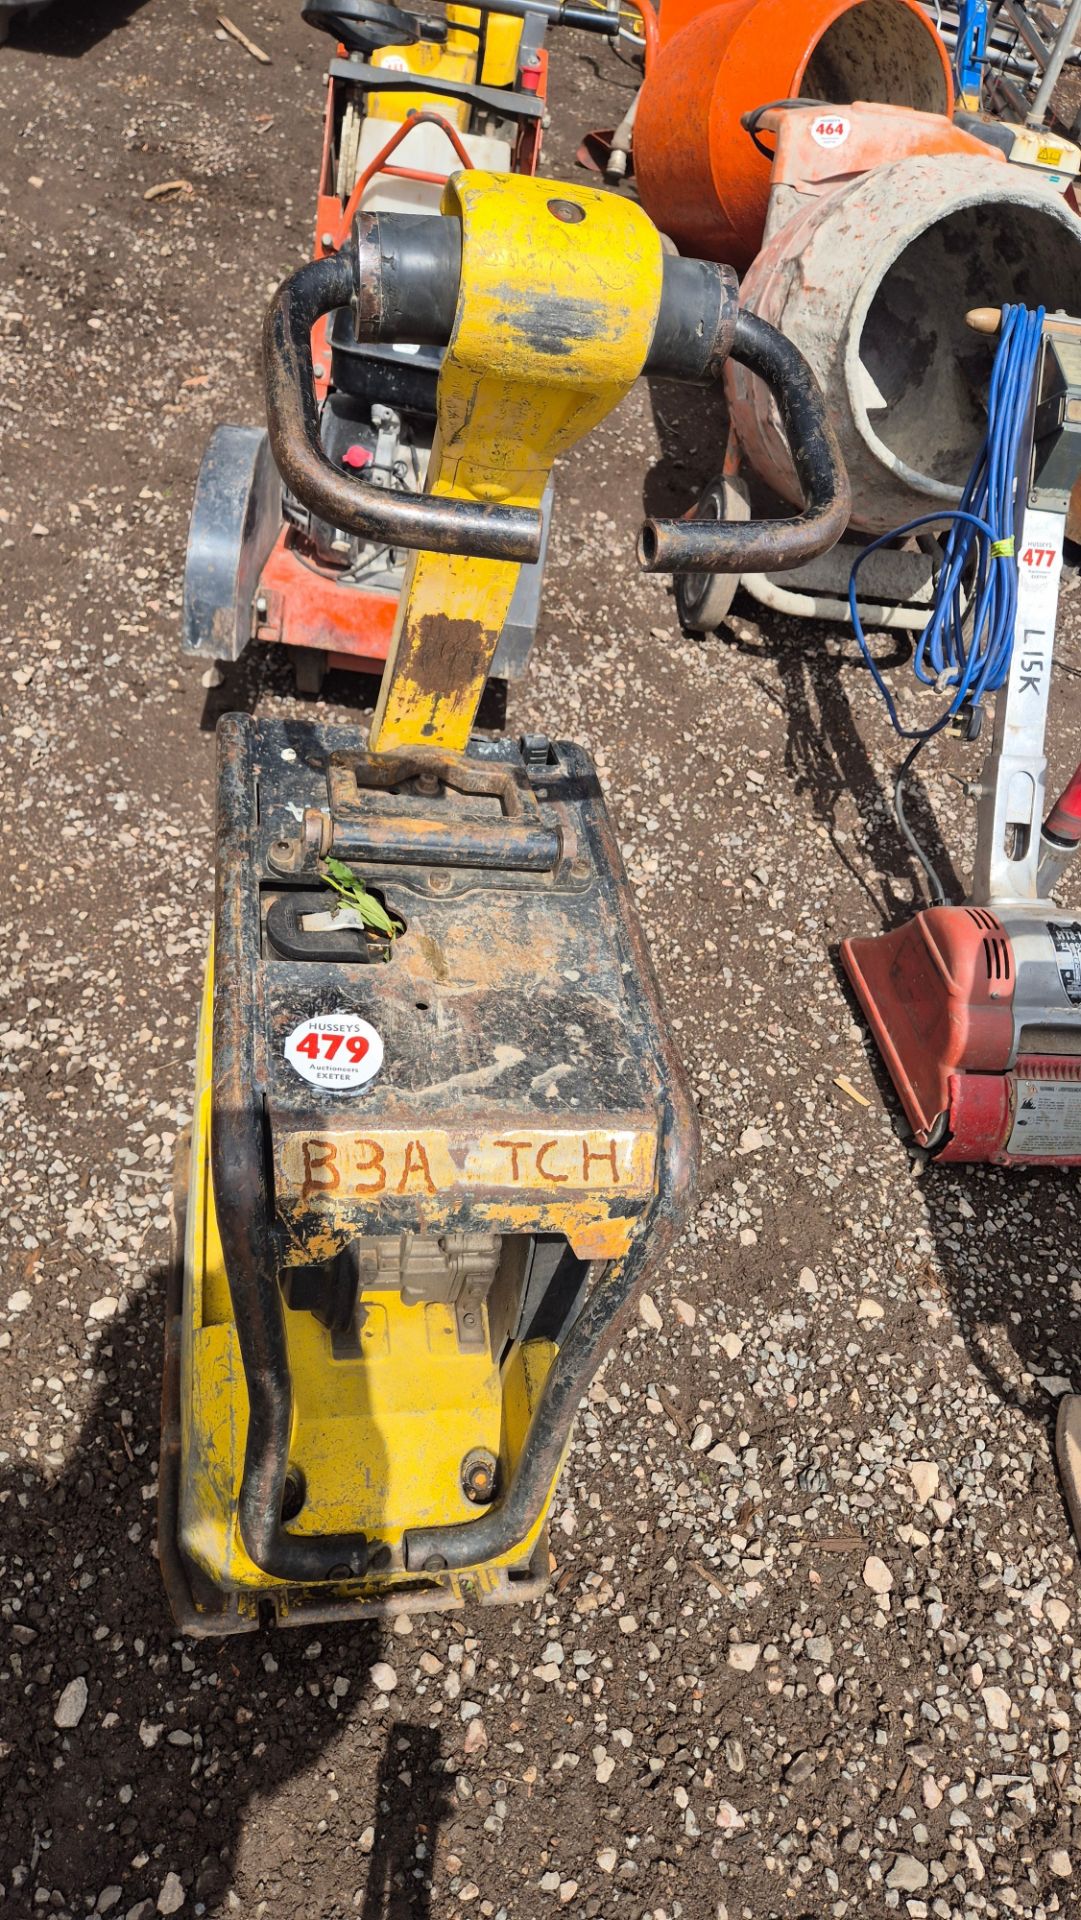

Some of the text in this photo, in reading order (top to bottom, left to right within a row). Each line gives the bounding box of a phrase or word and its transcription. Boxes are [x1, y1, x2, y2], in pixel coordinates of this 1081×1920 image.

[816, 123, 843, 135] 464
[1022, 548, 1056, 568] 477
[308, 1022, 361, 1033] HUSSEYS
[296, 1032, 370, 1064] 479
[309, 1063, 359, 1073] Auctioneers
[316, 1072, 352, 1081] EXETER
[493, 1139, 620, 1183] TCH
